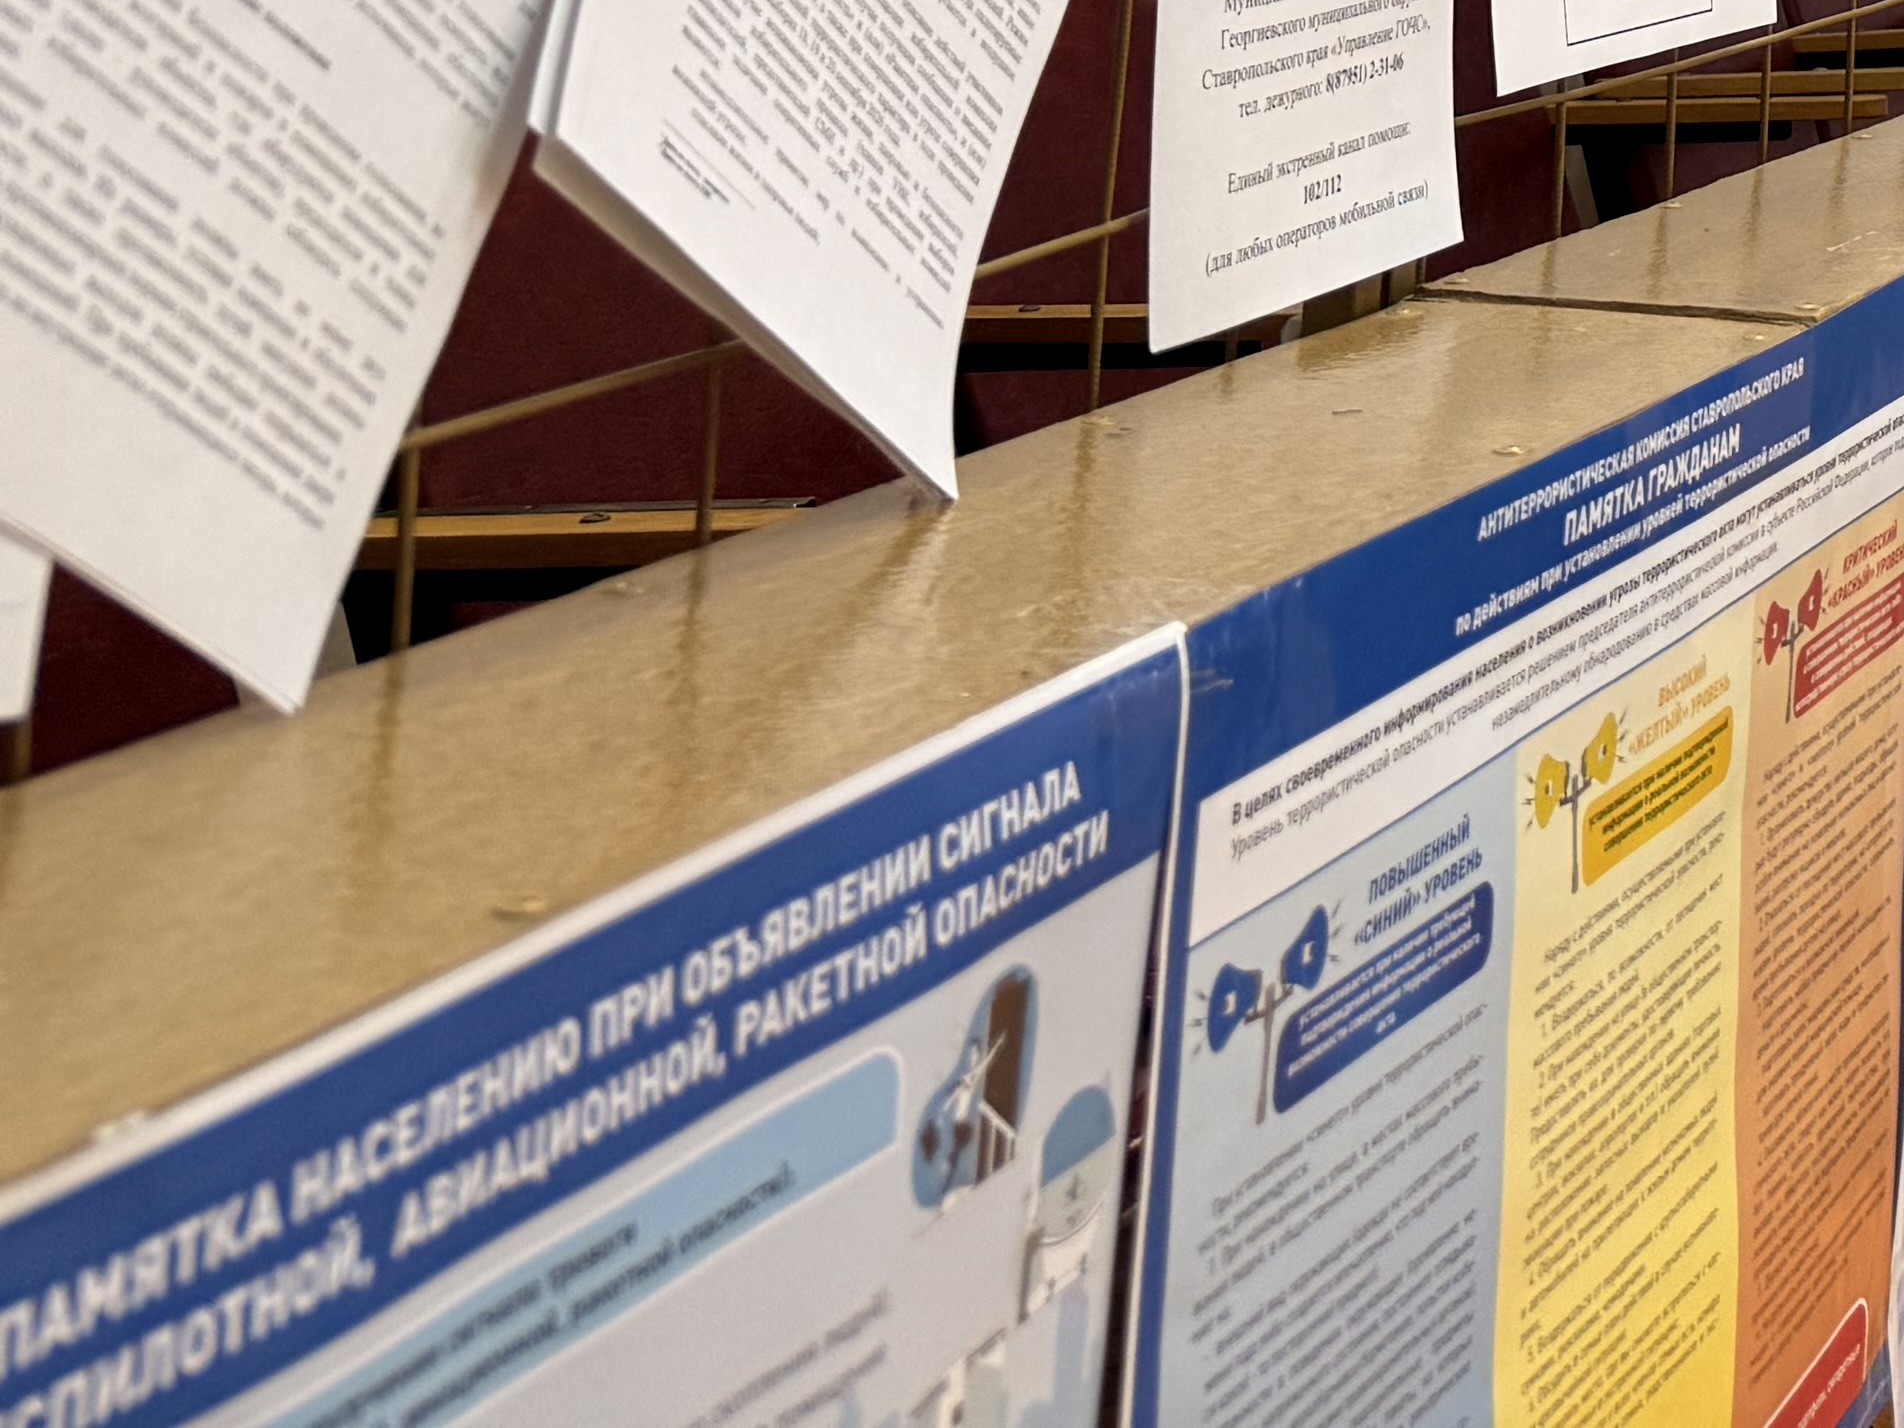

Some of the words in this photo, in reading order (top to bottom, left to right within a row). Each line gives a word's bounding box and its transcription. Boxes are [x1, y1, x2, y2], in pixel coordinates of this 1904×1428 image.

[1202, 50, 1304, 90] Ставропольского
[1306, 45, 1329, 68] края
[1221, 19, 1305, 50] Георгиевского
[1228, 163, 1273, 194] Единый
[1276, 143, 1335, 179] экстренный
[1303, 174, 1342, 204] 102/112
[1205, 249, 1233, 277] (для
[1235, 237, 1274, 265] любых
[1276, 212, 1336, 249] операторов
[1477, 446, 1634, 541] АНТИТЕРРОРИСТИЧЕСКАЯ
[1636, 417, 1690, 467] КОМИССИЯ
[1691, 374, 1780, 433] СТАВРОПОЛЬСКОГО
[1782, 357, 1804, 384] КРАЯ
[1564, 476, 1644, 545] ПАМЯТКА
[1647, 424, 1740, 500] ГРАЖДАНАМ
[1456, 616, 1471, 635] по
[1473, 582, 1539, 626] действиям
[1541, 570, 1563, 591] при
[1564, 524, 1640, 581] установлении
[1641, 500, 1683, 540] уровней
[1685, 446, 1768, 512] террористической
[1232, 802, 1241, 824] В
[1244, 783, 1282, 819] целях
[1286, 725, 1381, 794] своевременного
[1384, 670, 1472, 735] информирования
[1354, 887, 1421, 945] «СИНИЙ»
[1425, 847, 1483, 903] УРОВЕНЬ
[1369, 813, 1470, 904] ПОВЫШЕННЫЙ
[0, 1182, 283, 1380] ПАМЯТКА
[292, 1013, 581, 1225] НАСЕЛЕНИЮ
[588, 966, 674, 1058] ПРИ
[681, 845, 932, 1007] ОБЪЯВЛЕНИИ
[939, 760, 1083, 872] СИГНАЛА
[391, 1029, 726, 1261] АВИАЦИОННОЙ,
[732, 922, 928, 1058] РАКЕТНОЙ
[934, 809, 1110, 944] ОПАСНОСТИ
